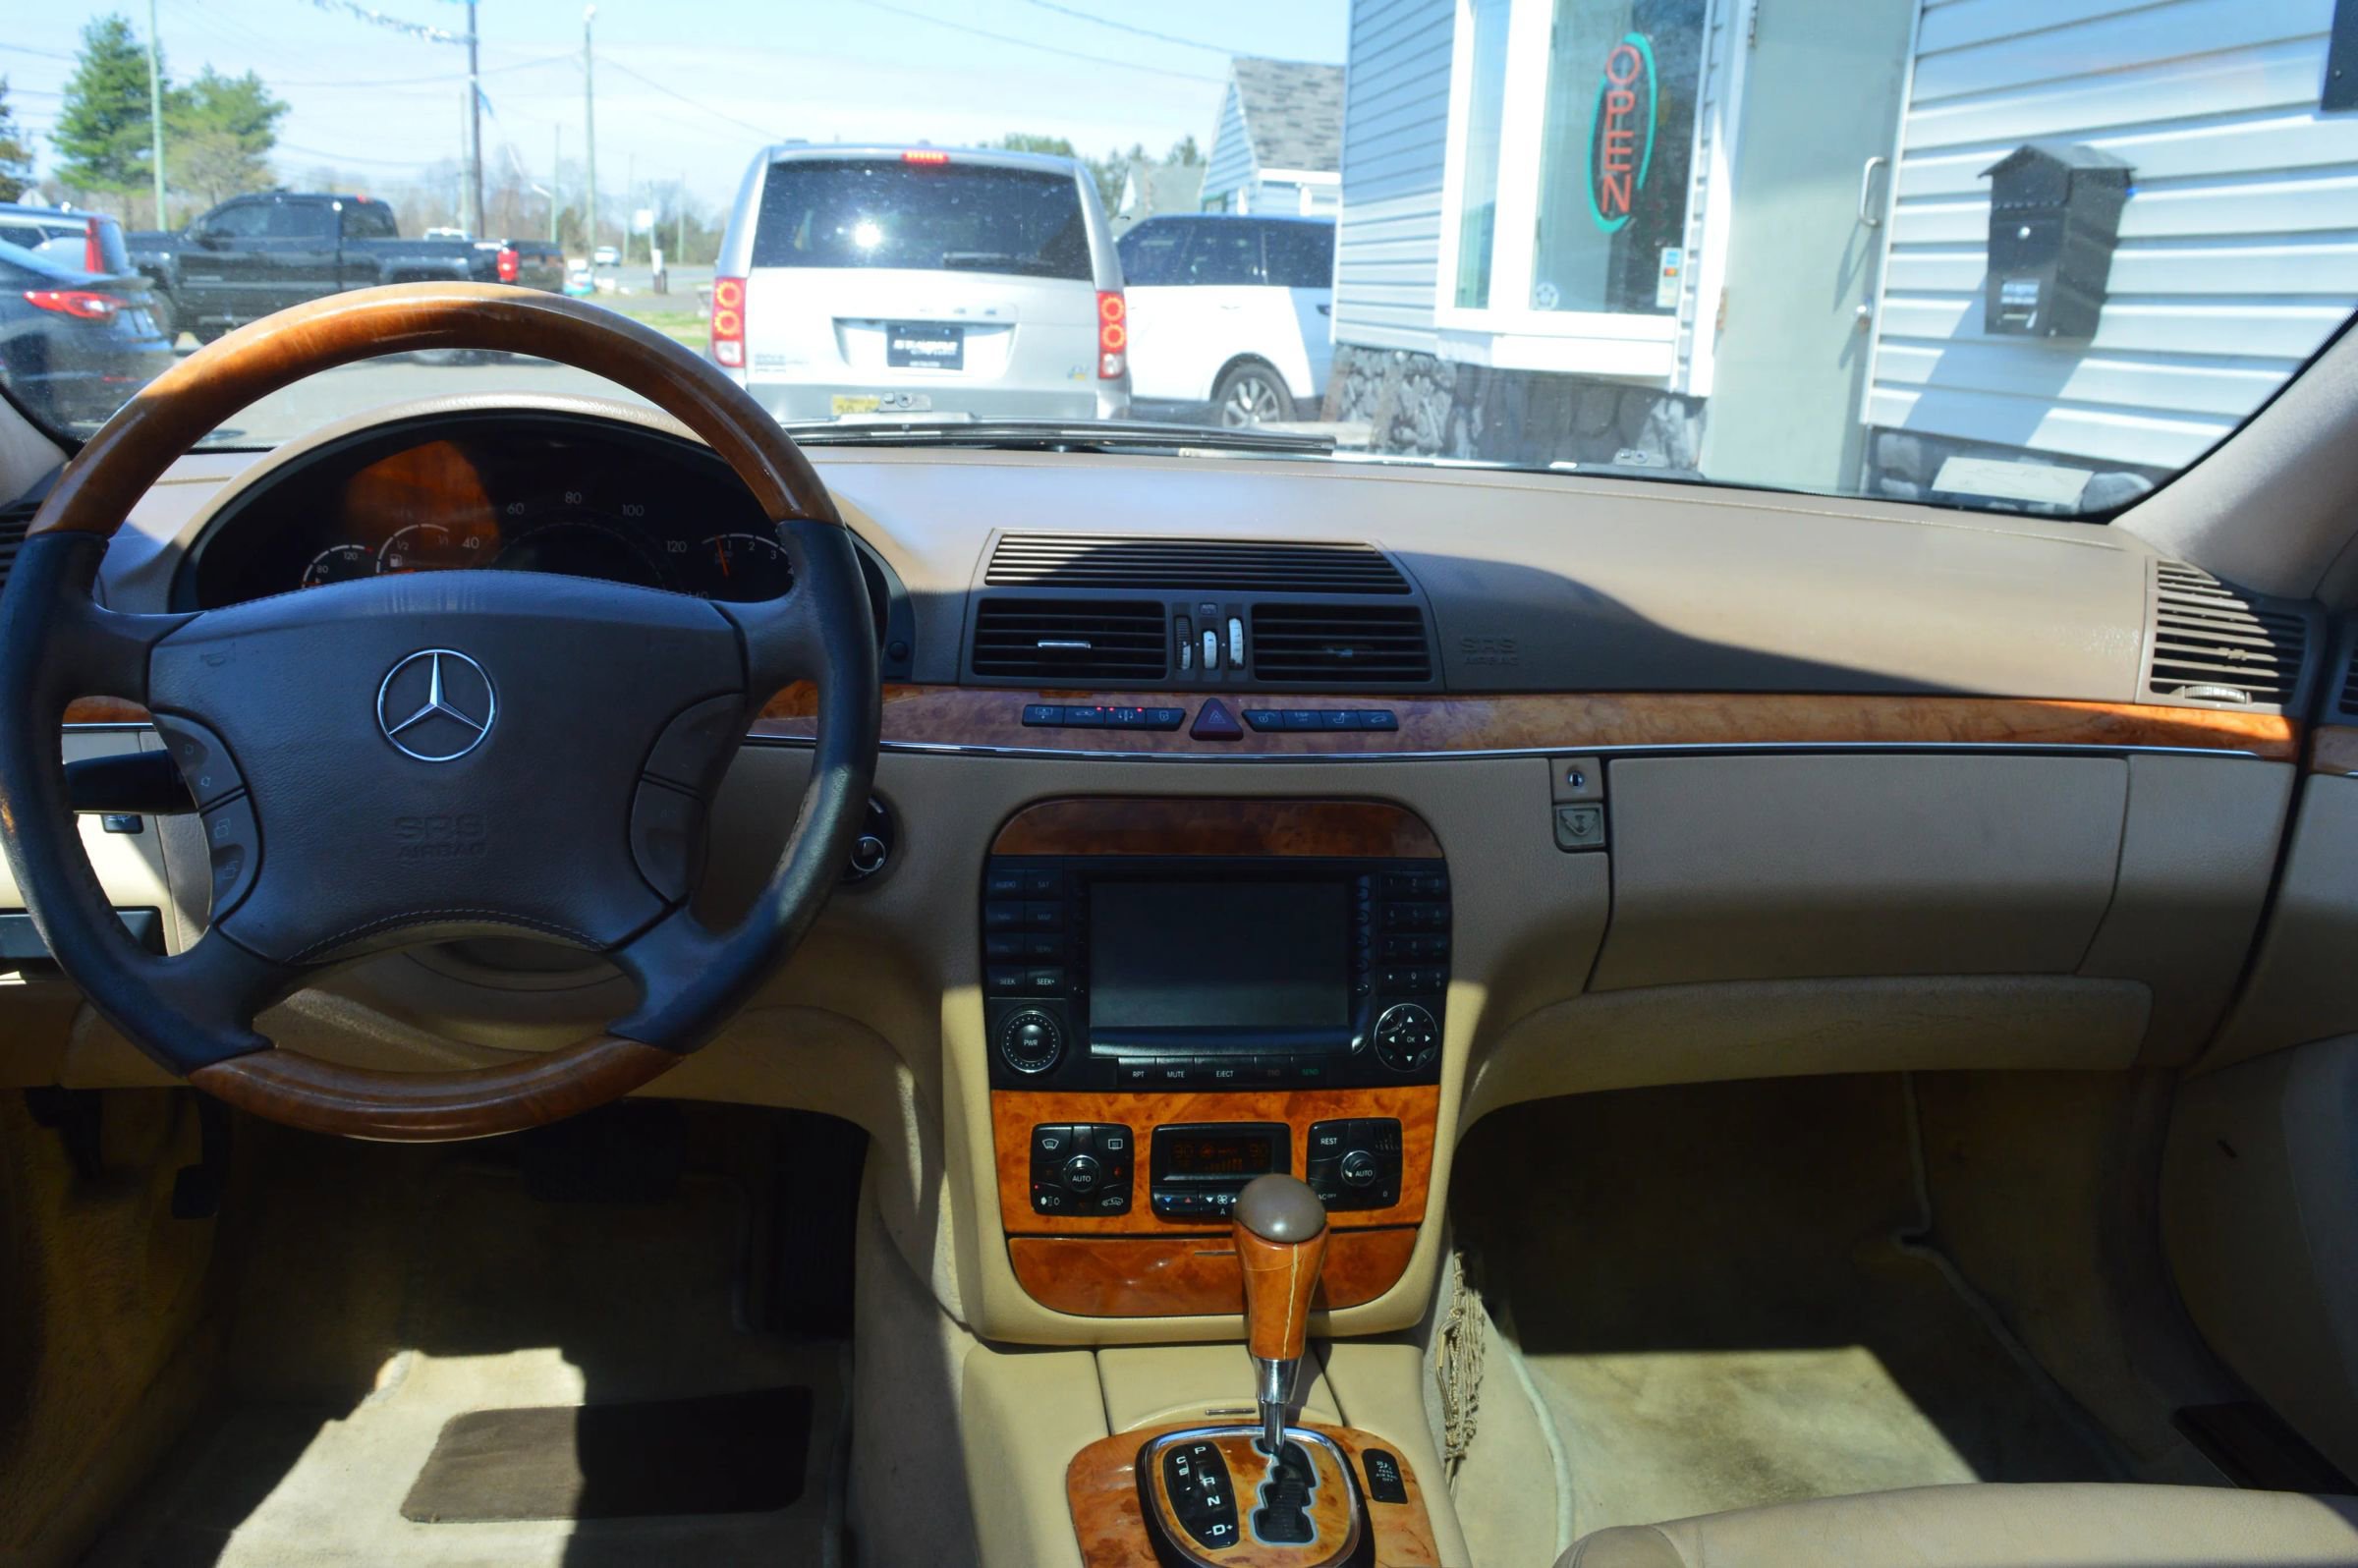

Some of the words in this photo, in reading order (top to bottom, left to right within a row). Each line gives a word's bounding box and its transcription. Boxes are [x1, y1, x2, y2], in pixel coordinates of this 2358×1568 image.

[1600, 43, 1643, 213] OPEN
[565, 491, 583, 504] 80
[506, 502, 525, 516] 60
[622, 504, 645, 517] 100
[461, 536, 480, 550] 40
[666, 540, 688, 553] 120
[727, 540, 732, 550] 1
[748, 541, 756, 551] 2
[343, 552, 359, 561] 120
[770, 549, 777, 560] 3
[1166, 1070, 1186, 1079] MUTE
[1319, 1137, 1338, 1146] REST
[1178, 1467, 1189, 1476] S
[1203, 1477, 1215, 1486] R
[1207, 1495, 1221, 1506] N
